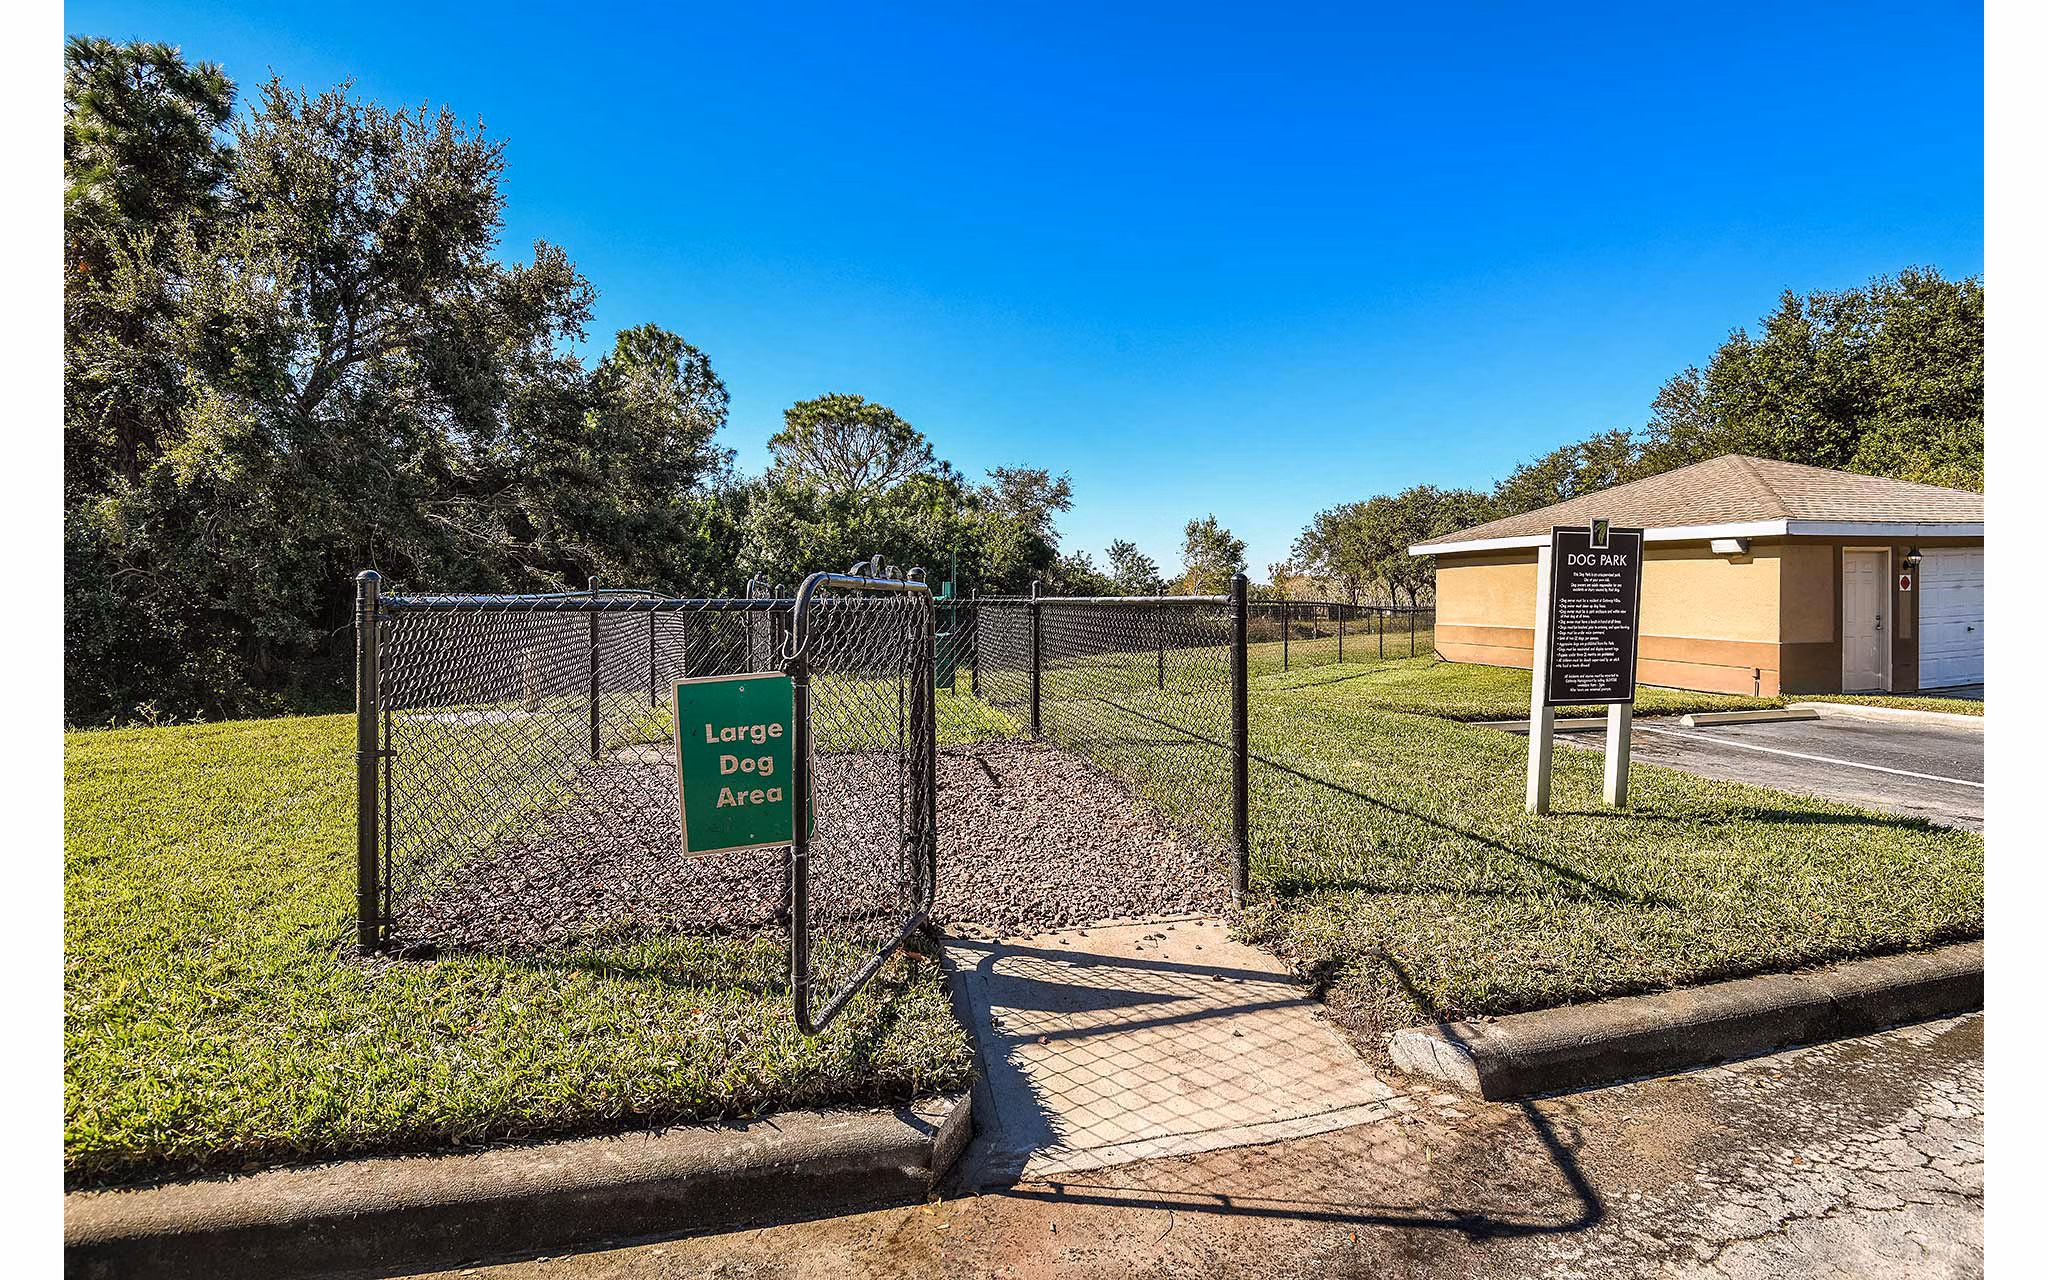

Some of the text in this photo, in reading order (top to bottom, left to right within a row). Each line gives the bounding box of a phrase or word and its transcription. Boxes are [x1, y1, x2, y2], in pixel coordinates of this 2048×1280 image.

[1567, 553, 1628, 566] DOG PARK
[705, 722, 783, 745] Large
[719, 754, 774, 777] Dog
[716, 786, 783, 809] Area
